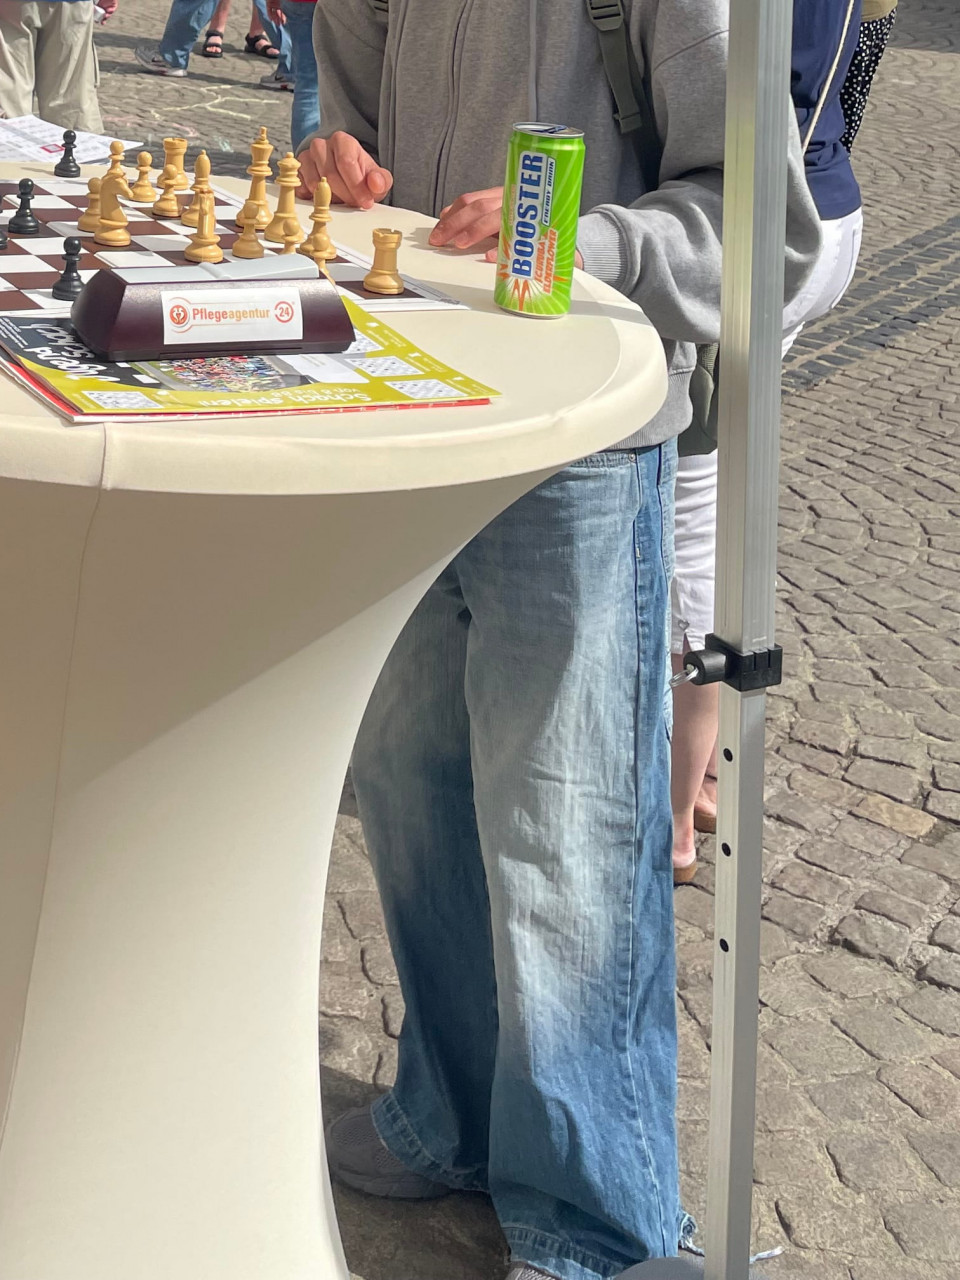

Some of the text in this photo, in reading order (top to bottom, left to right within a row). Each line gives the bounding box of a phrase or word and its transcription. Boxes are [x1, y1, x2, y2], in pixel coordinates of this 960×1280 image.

[511, 153, 544, 278] BOOSTER
[542, 228, 558, 294] ELDERFLOWER
[192, 308, 270, 322] Pflegeagentur
[290, 392, 372, 405] Schach
